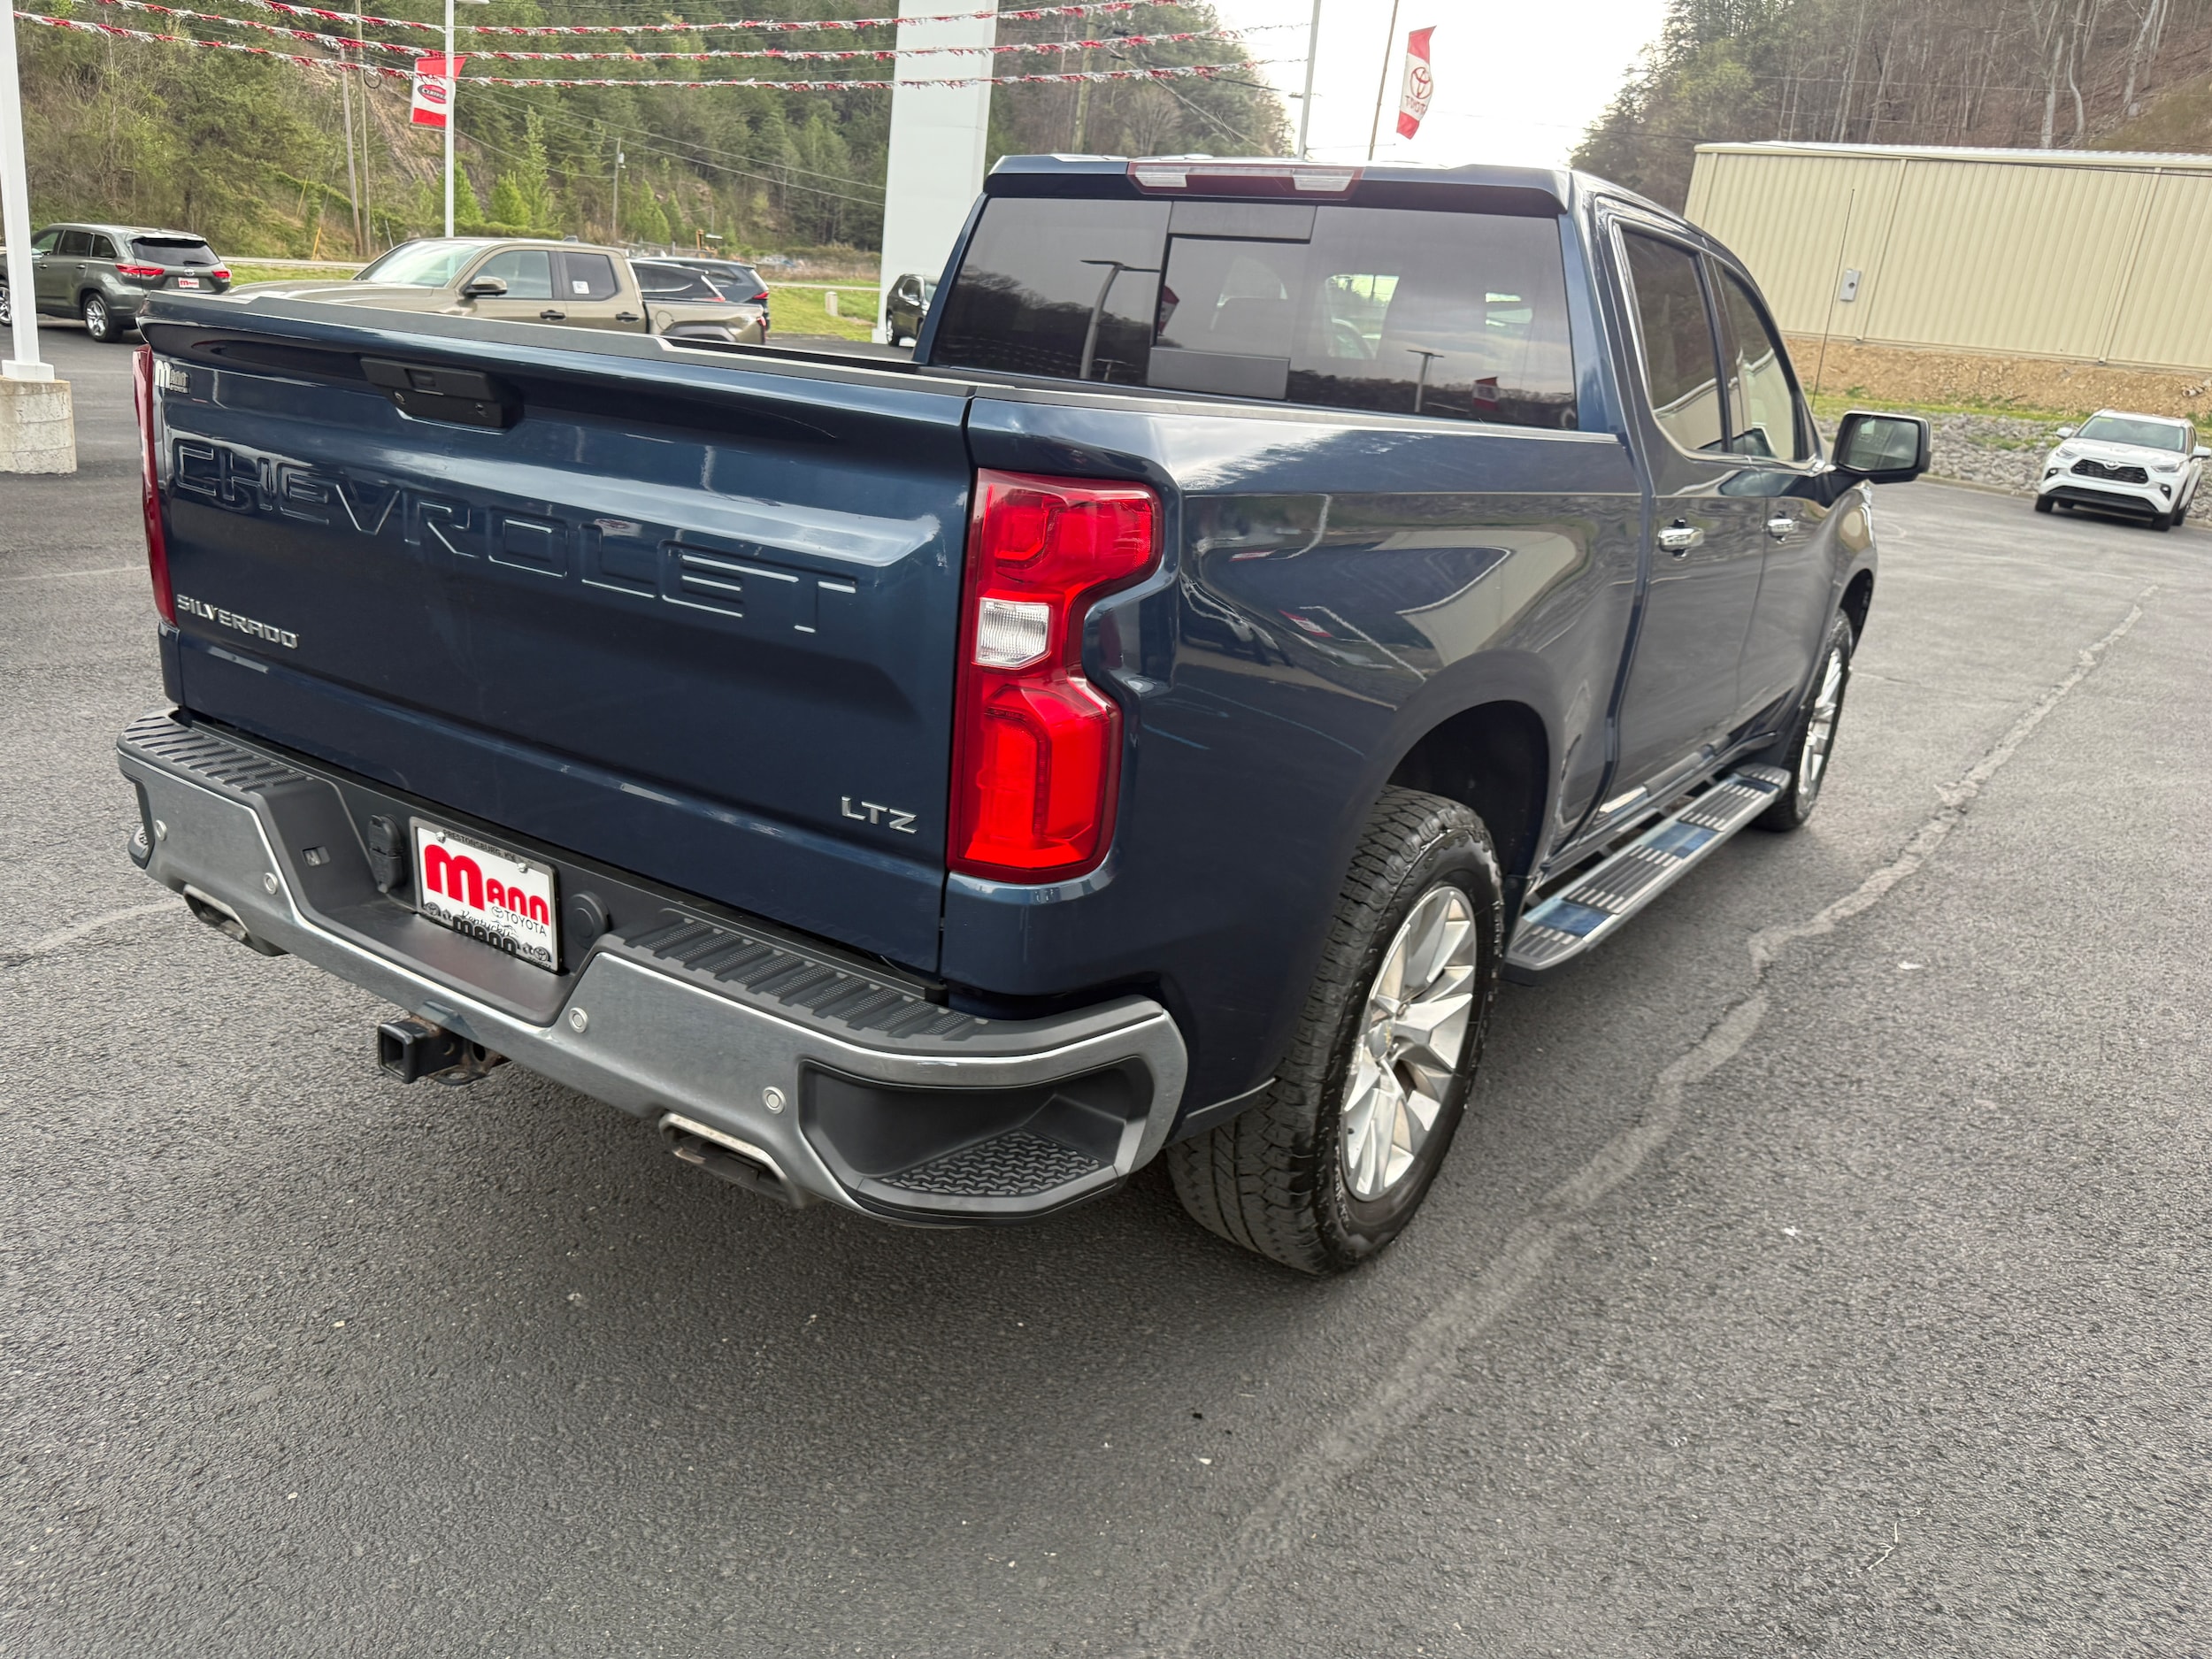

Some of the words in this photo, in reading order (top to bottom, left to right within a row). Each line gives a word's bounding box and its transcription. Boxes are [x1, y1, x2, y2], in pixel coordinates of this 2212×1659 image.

[173, 439, 857, 634] CHEVROLET
[177, 594, 298, 649] SILVERADO
[841, 796, 918, 833] LTZ
[504, 910, 547, 937] TOYOTA
